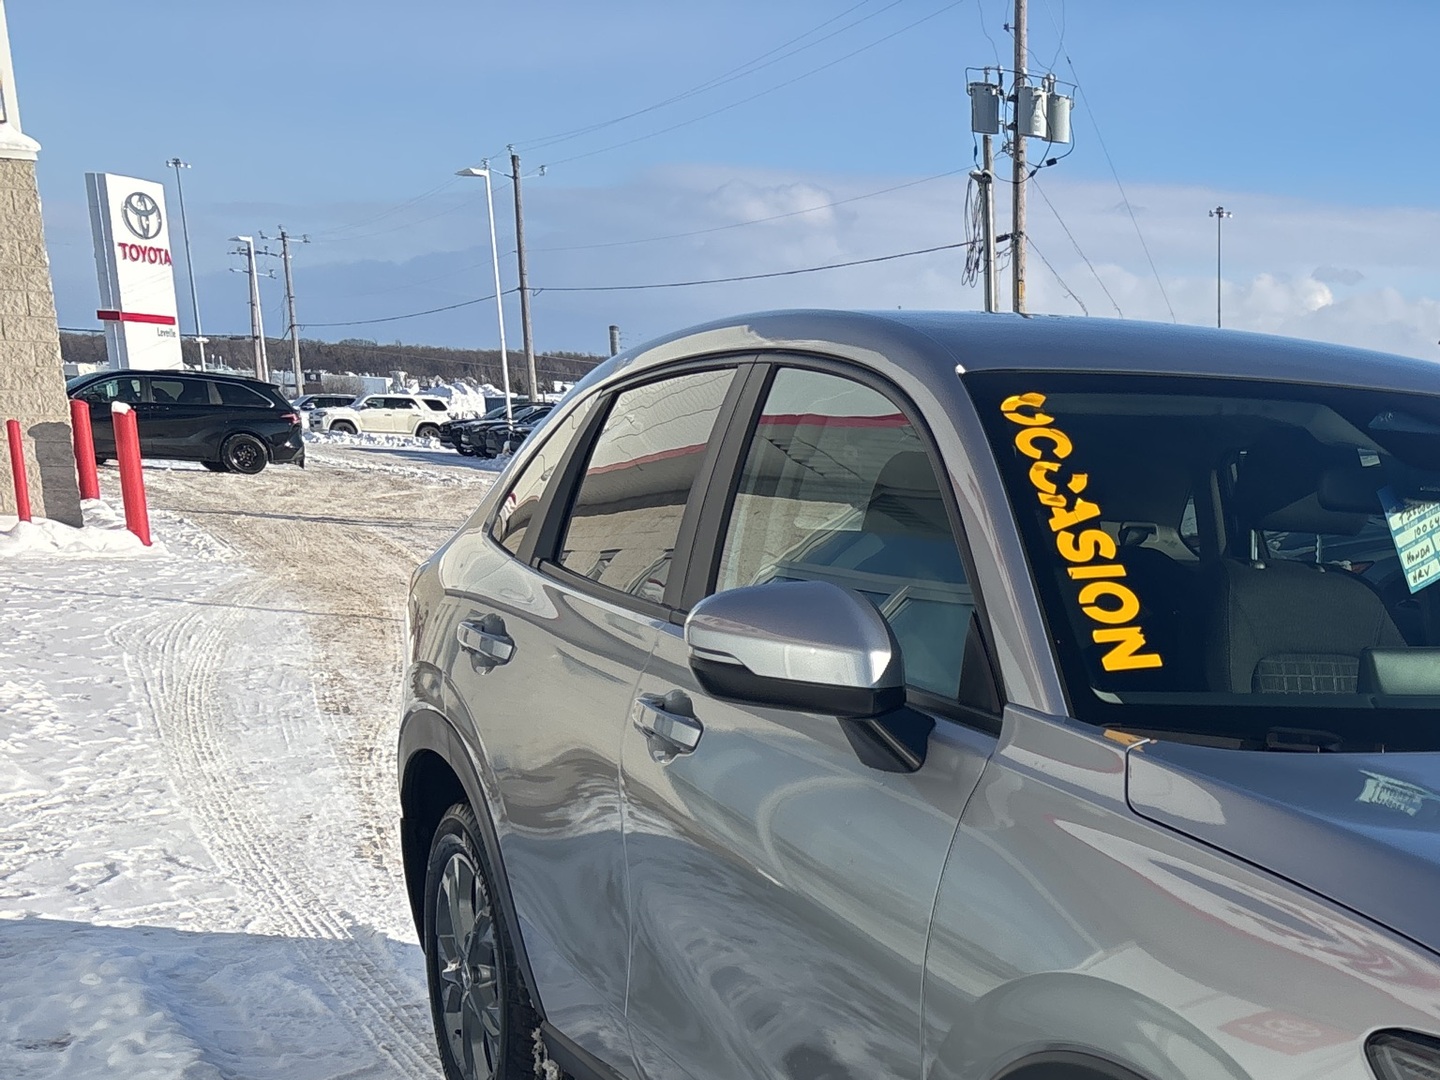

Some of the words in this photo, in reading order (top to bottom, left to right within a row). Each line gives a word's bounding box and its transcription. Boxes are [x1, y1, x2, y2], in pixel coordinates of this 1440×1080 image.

[117, 242, 172, 266] TOYOTA
[1000, 392, 1163, 671] OCCASION
[1406, 545, 1430, 565] HONDA
[1412, 565, 1430, 583] HRV
